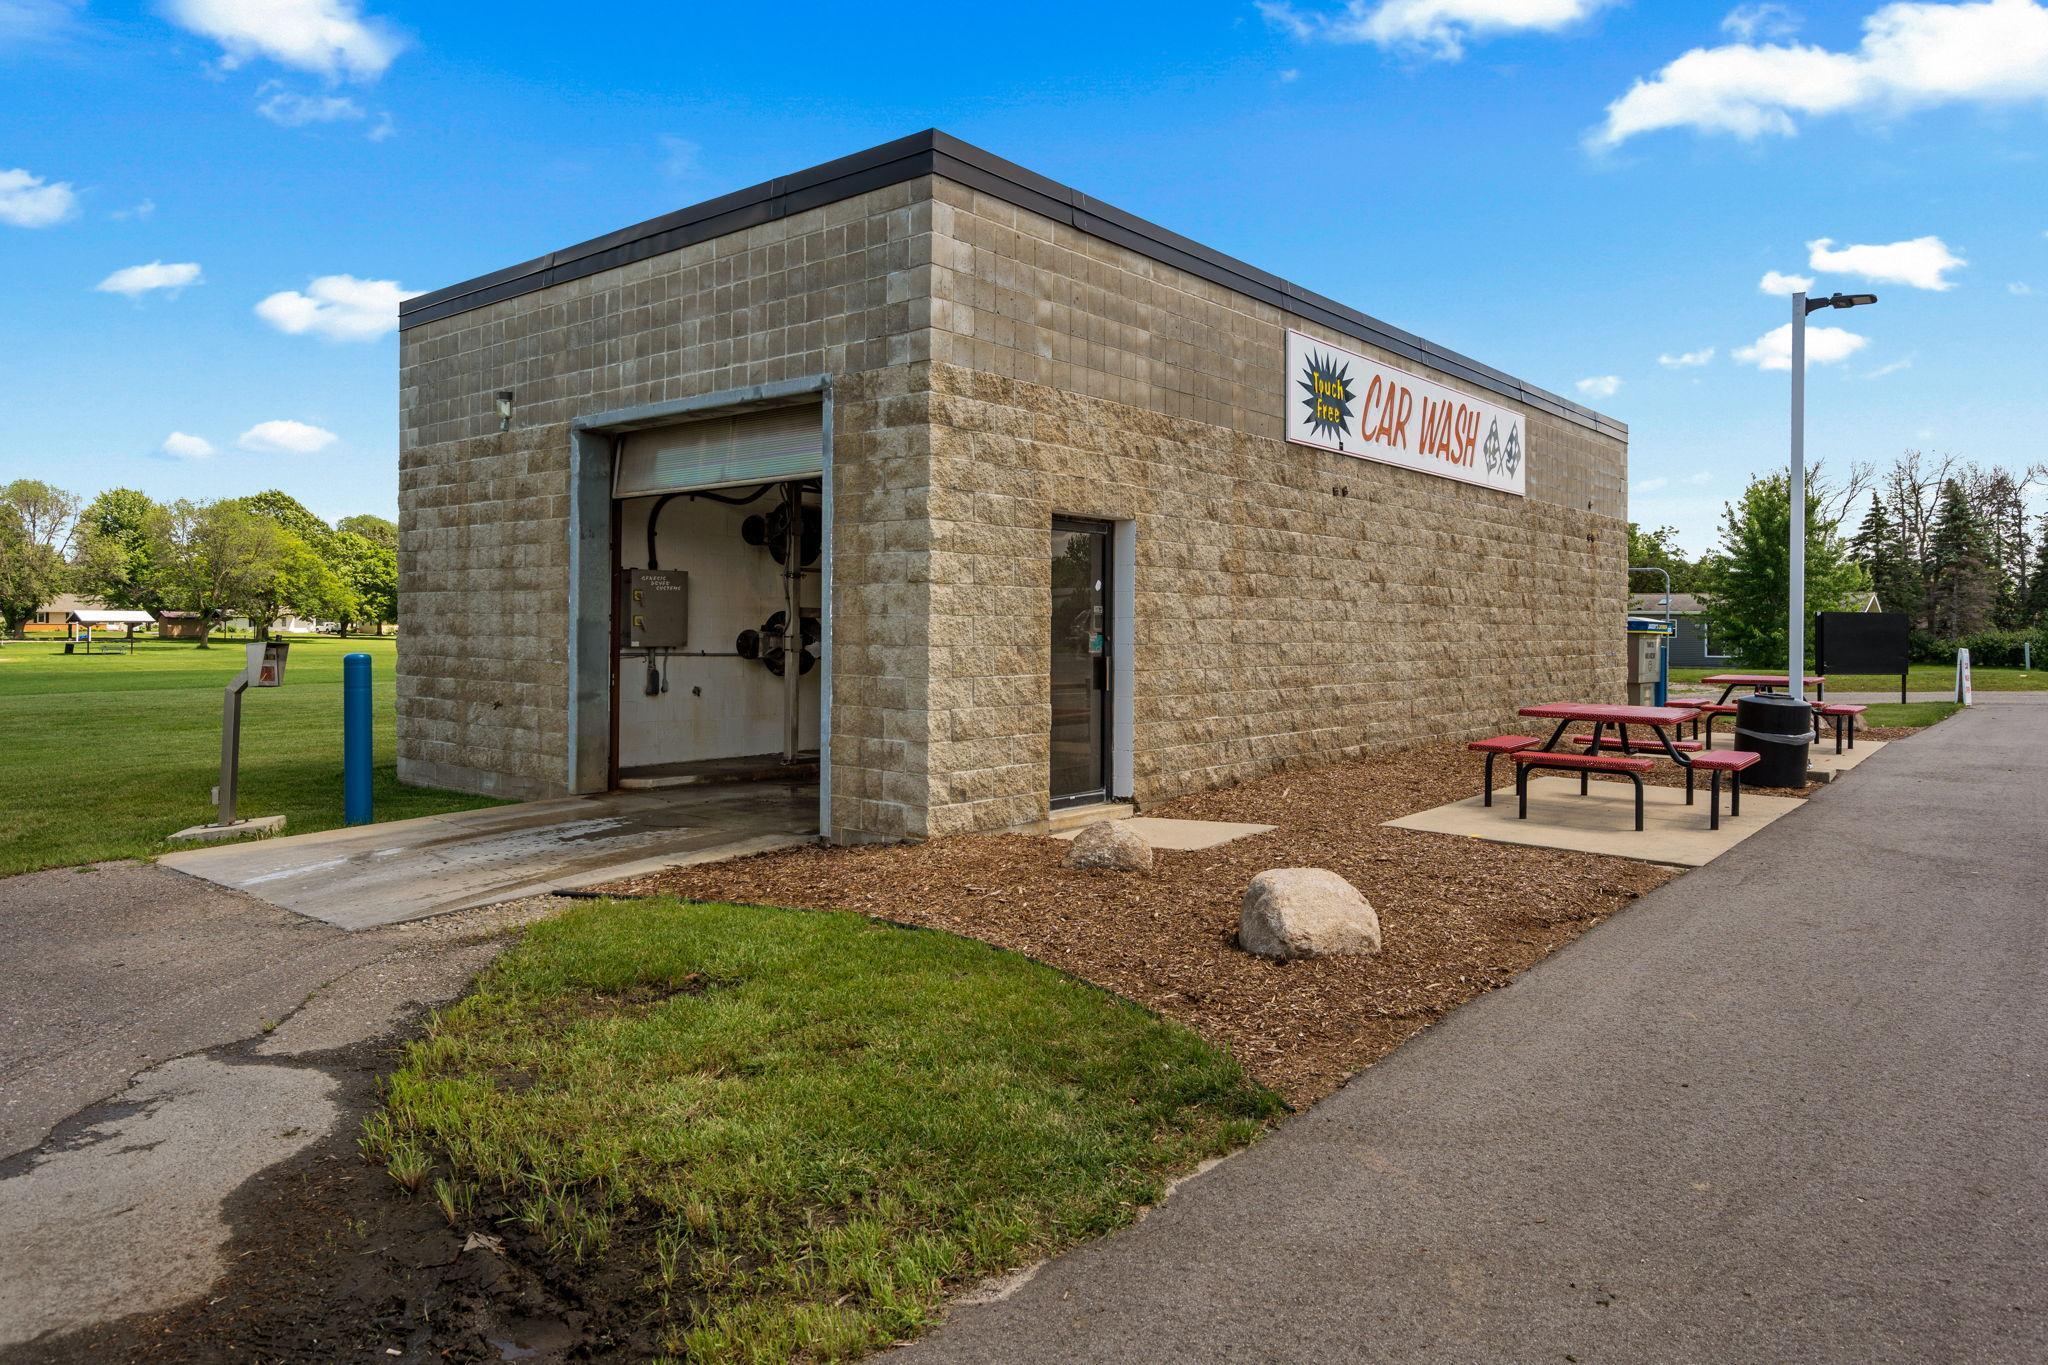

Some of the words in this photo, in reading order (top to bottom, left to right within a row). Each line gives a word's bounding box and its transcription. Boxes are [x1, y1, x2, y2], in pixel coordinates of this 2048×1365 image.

[1313, 371, 1344, 399] Touch
[1316, 397, 1341, 423] Free
[1361, 374, 1413, 449] CAR
[1419, 396, 1481, 468] WASH
